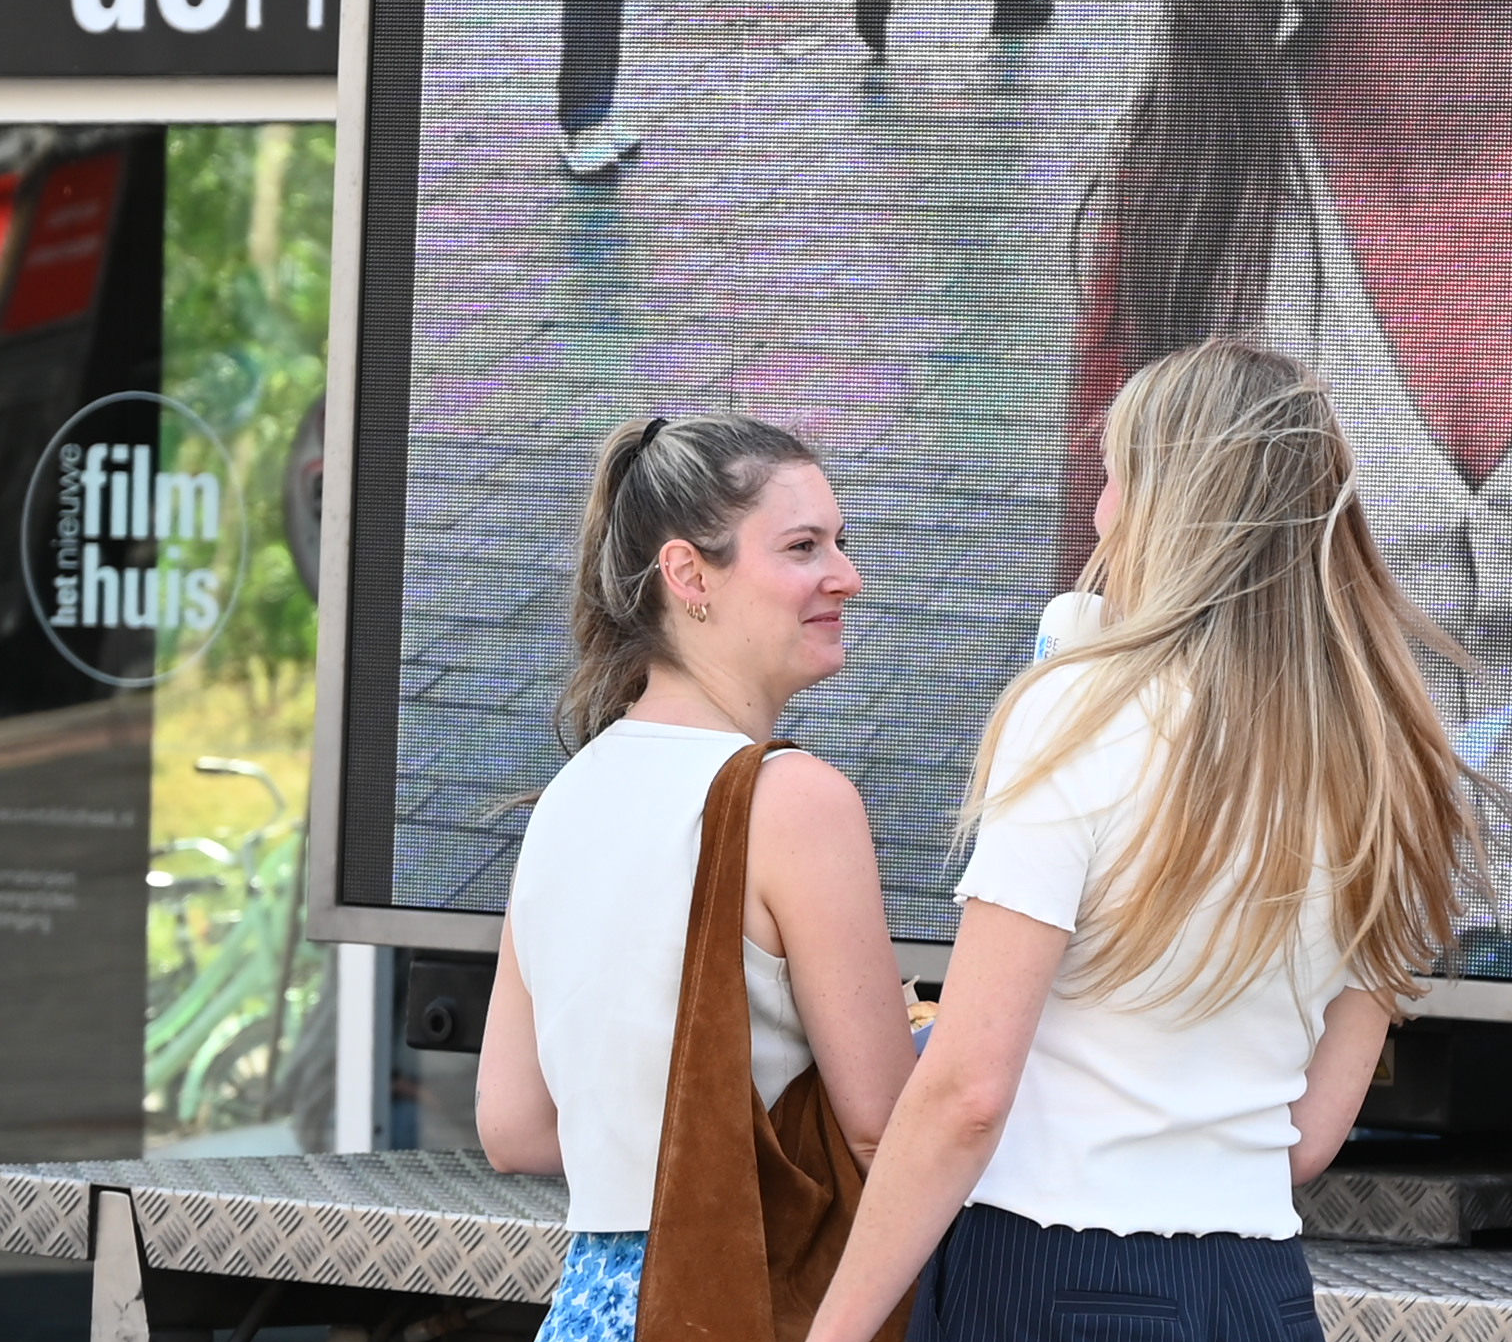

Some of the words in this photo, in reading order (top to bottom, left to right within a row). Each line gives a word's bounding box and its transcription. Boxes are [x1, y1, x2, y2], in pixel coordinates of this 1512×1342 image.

[49, 442, 82, 570] nieuwe
[80, 442, 220, 540] film
[50, 573, 79, 627] het
[82, 541, 220, 630] huis
